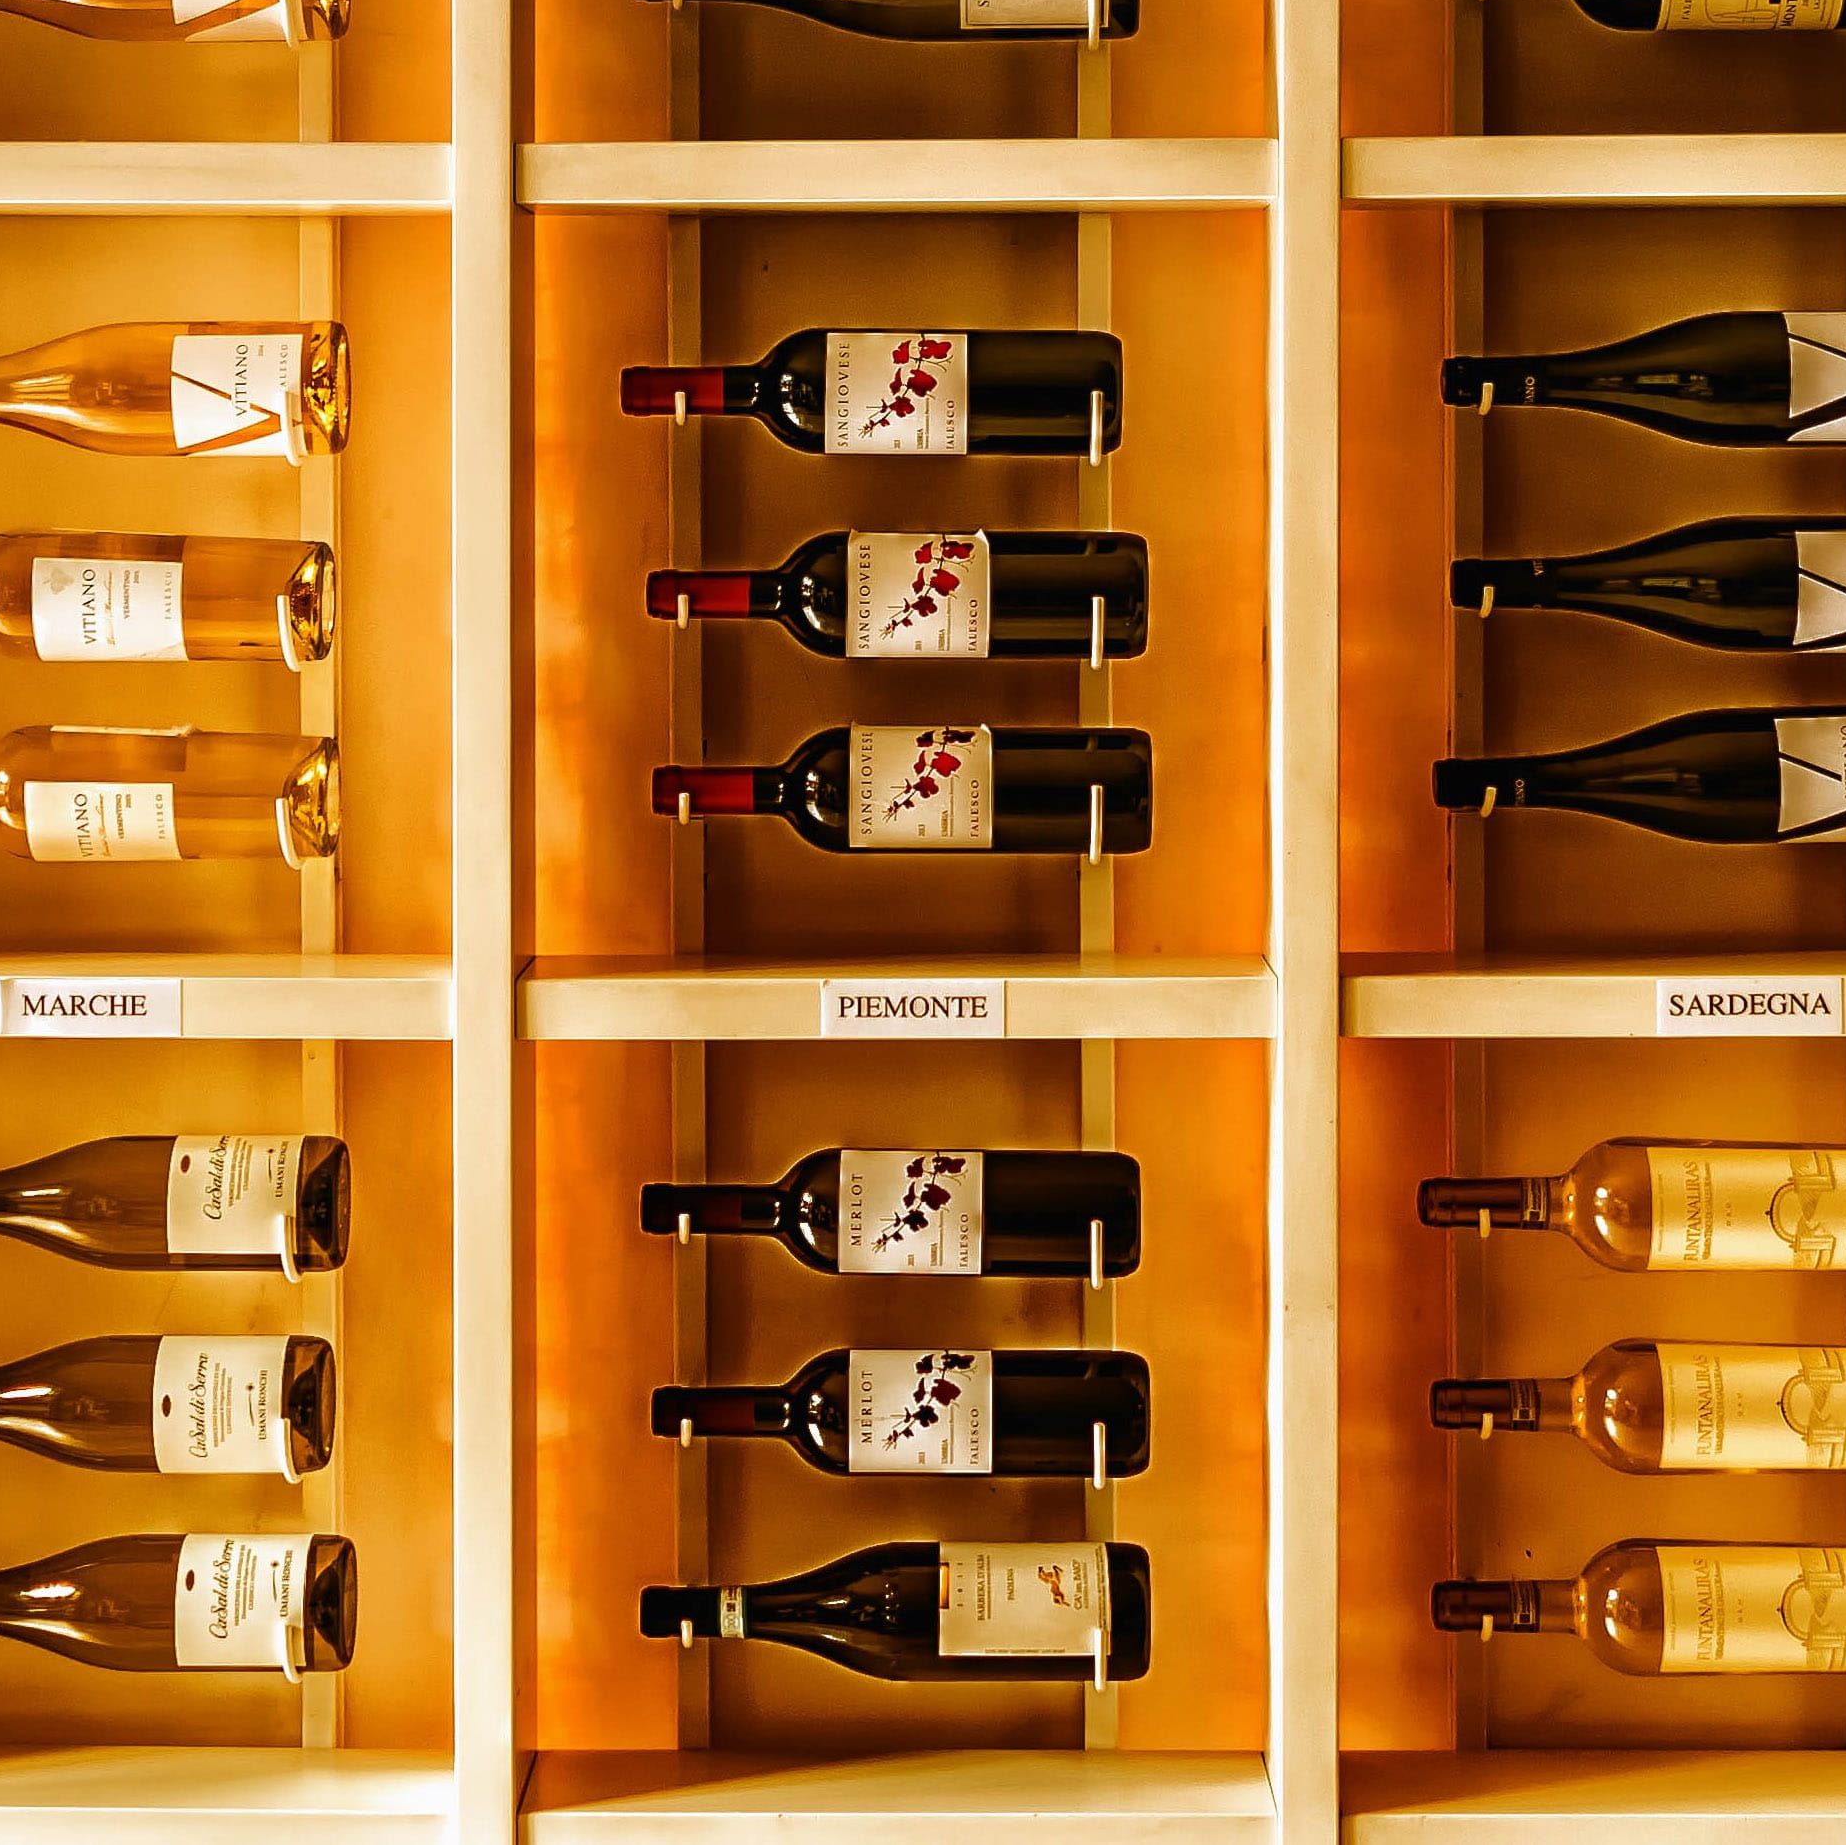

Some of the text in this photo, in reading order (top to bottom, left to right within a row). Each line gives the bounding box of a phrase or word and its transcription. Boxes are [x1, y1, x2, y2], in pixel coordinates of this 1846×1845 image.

[235, 345, 249, 417] VITIANO
[279, 345, 288, 387] ALESCO
[837, 342, 850, 447] SANGIOVESE
[946, 400, 955, 449] FALESCO
[82, 569, 98, 645] VITIANO
[123, 570, 131, 619] VERMENTINO
[164, 571, 172, 620] FALESCO
[859, 545, 872, 650] SANGIOVESE
[969, 599, 978, 651] FALESCO
[861, 732, 874, 834] SANGIOVESE
[970, 780, 978, 837] FALESCO
[74, 794, 93, 857] VITIANO
[115, 794, 125, 840] VERMENTINO
[155, 794, 164, 839] FALESCO
[22, 995, 147, 1016] MARCHE
[838, 996, 988, 1019] PIEMONTE
[1668, 994, 1831, 1017] SARDEGNA
[275, 1166, 285, 1197] UMANI
[850, 1173, 863, 1246] MERLOT
[1684, 1162, 1700, 1261] FUNTANALIRAS
[959, 1214, 969, 1268] FALESCO
[190, 1353, 207, 1397] Serra
[257, 1370, 268, 1440] UMANI RONCHI
[860, 1369, 873, 1444] MERLOT
[1694, 1355, 1713, 1456] FUNTANALIRAS
[970, 1408, 979, 1465] FALESCO
[213, 1539, 233, 1577] Serra
[279, 1550, 293, 1617] UMANI RONCHI
[977, 1579, 986, 1621] BARBERA
[1696, 1559, 1713, 1661] FUNTANALIRAS
